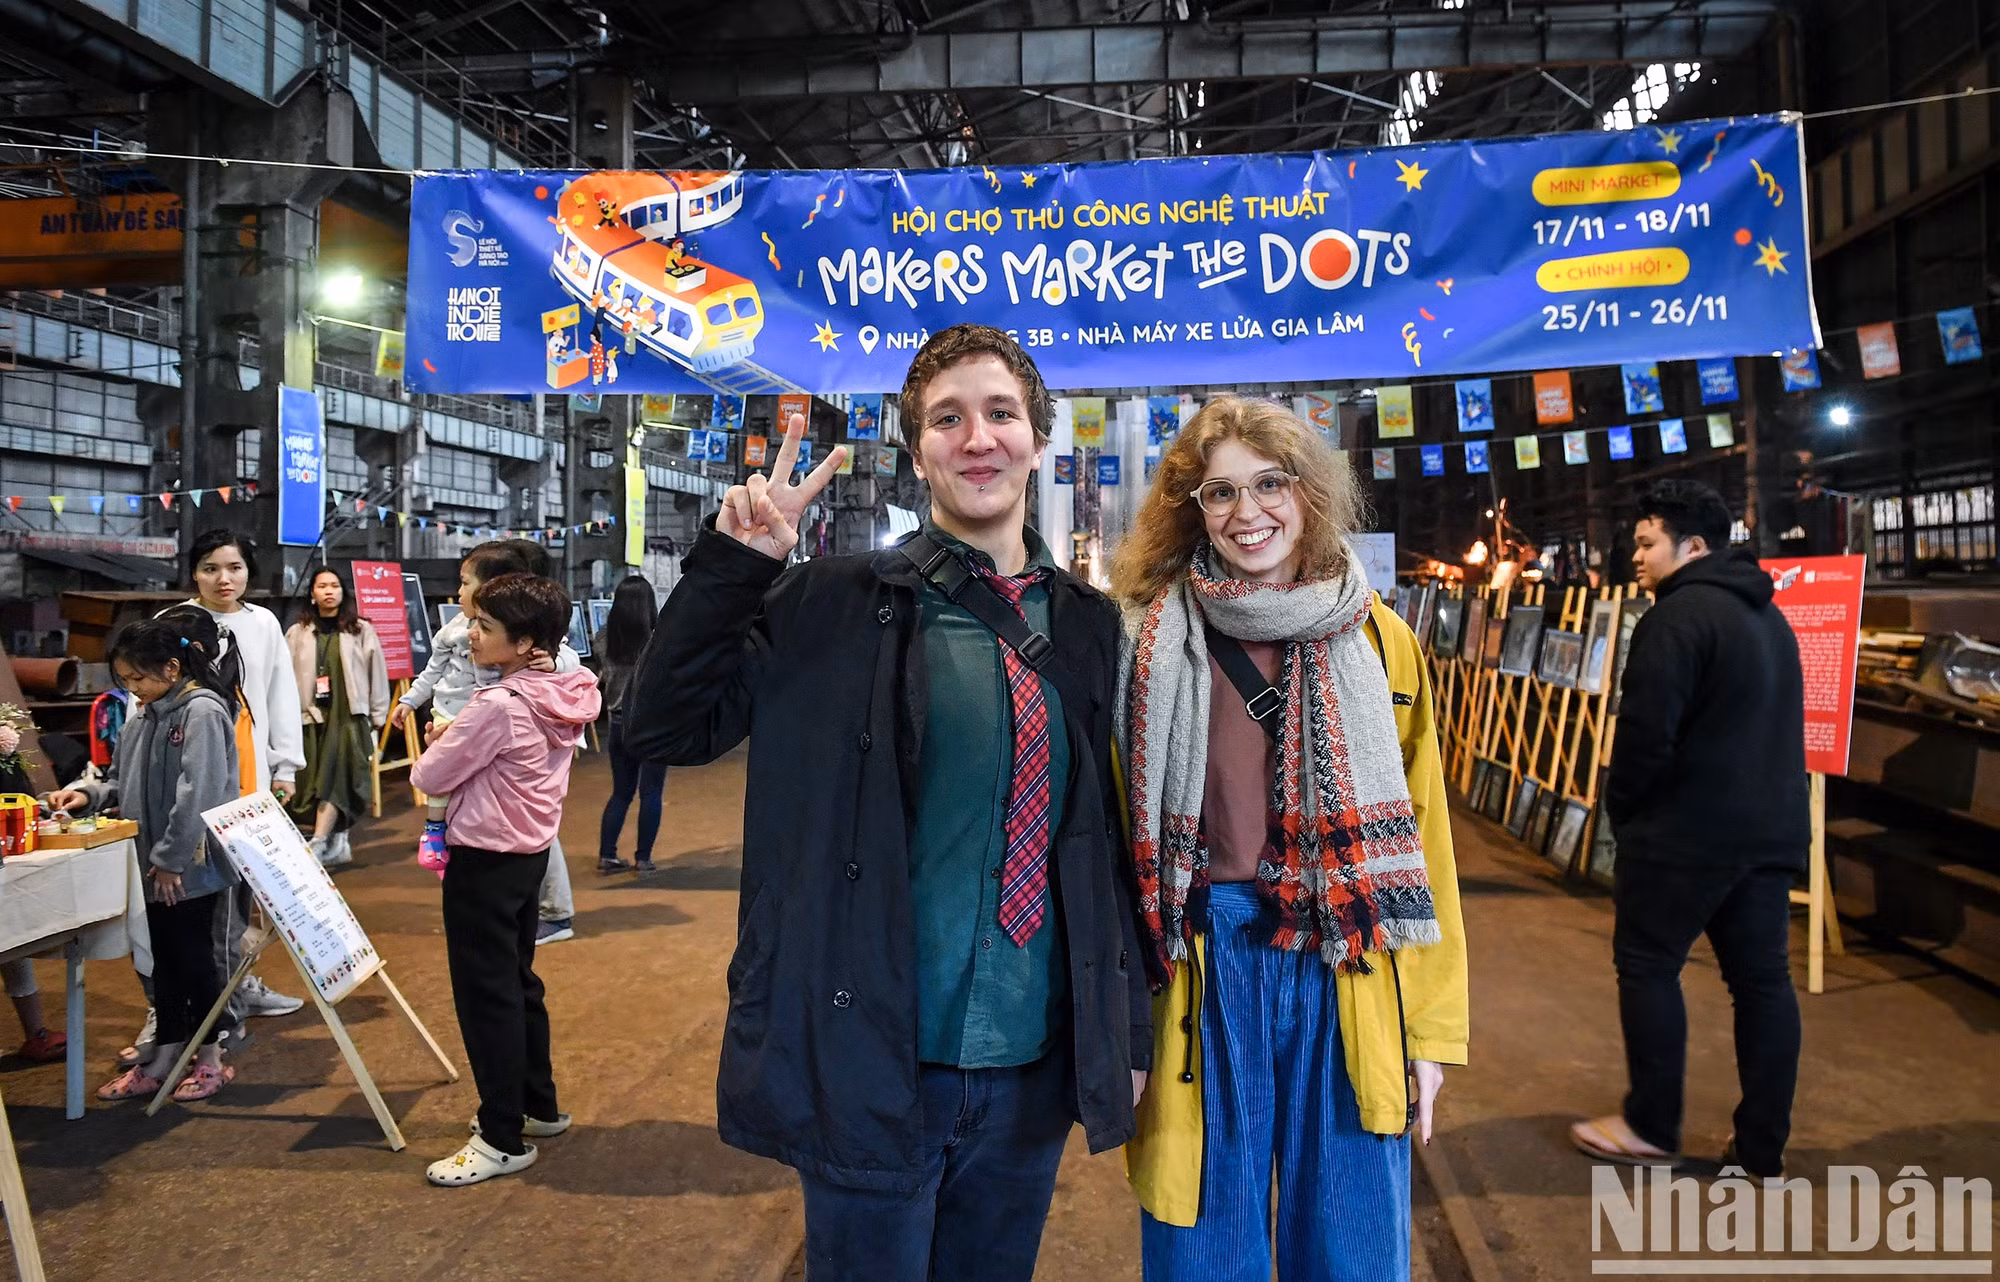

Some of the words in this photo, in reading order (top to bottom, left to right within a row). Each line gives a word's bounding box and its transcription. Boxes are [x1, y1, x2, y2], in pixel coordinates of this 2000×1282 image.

[1550, 178, 1585, 194] MINI
[1591, 172, 1662, 192] MARKET
[41, 213, 66, 235] AN
[892, 205, 936, 237] HỘI
[944, 206, 1003, 236] CHỢ
[1010, 199, 1065, 231] THỦ
[1073, 198, 1151, 227] CÔNG
[1159, 193, 1234, 226] NGHỆ
[1242, 188, 1330, 220] THUẬT
[1533, 215, 1605, 248] 17/11
[1635, 202, 1711, 234] 18/11
[1259, 228, 1411, 294] DOTS
[1567, 261, 1624, 281] CHÍNH
[1630, 256, 1661, 277] HỘI
[447, 287, 502, 306] HANOI
[1542, 300, 1620, 333] 25/11
[1650, 293, 1728, 327] 26/11
[1026, 328, 1054, 347] 3B
[1077, 322, 1126, 345] NHÀ
[1133, 319, 1177, 343] MÁY
[1185, 322, 1214, 341] XE
[1221, 315, 1264, 340] LỬA
[1271, 317, 1310, 338] GIA
[1317, 311, 1364, 335] LÂM
